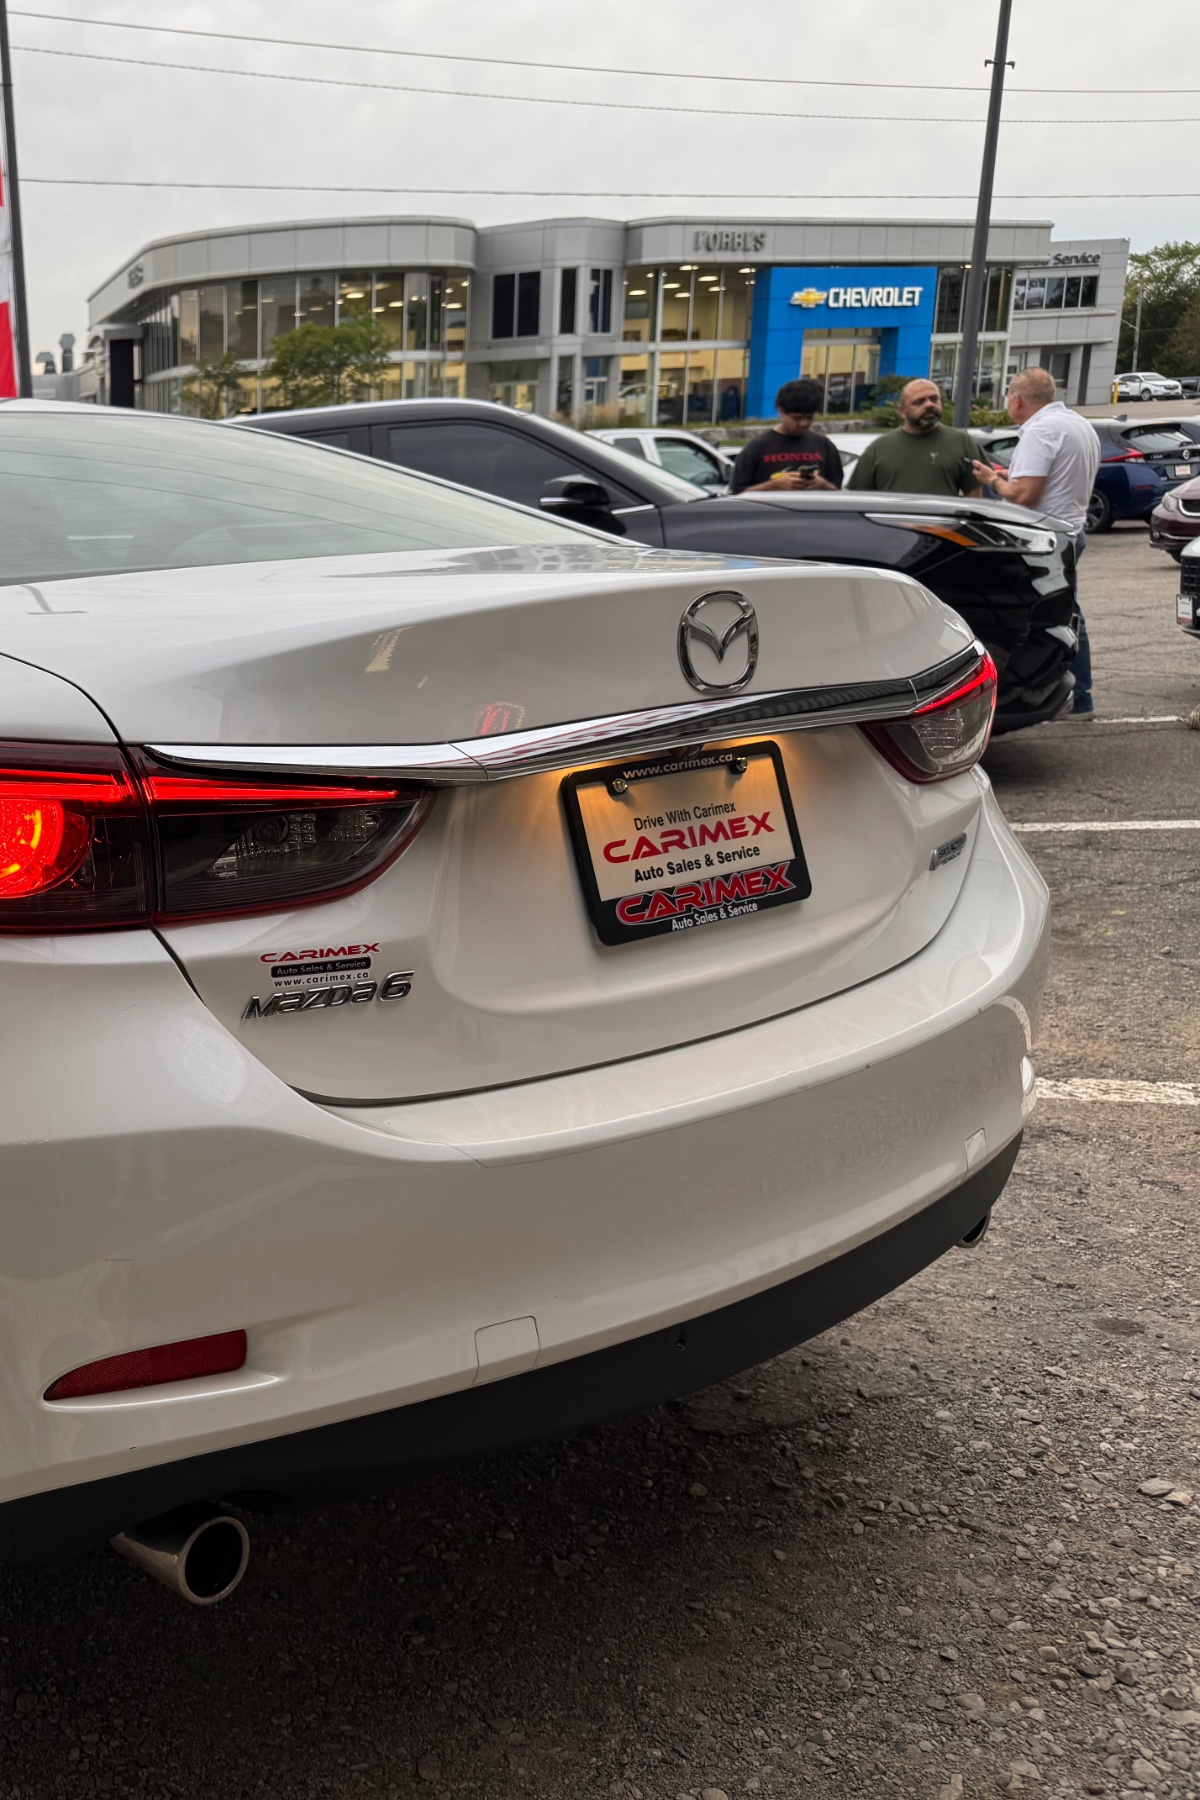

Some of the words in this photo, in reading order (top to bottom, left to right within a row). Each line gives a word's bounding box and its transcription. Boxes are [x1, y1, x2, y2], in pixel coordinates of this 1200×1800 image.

[1053, 252, 1101, 265] Service
[828, 286, 923, 308] CHEVROLET
[764, 452, 823, 463] HONDA
[623, 752, 734, 779] www.carimex.ca
[633, 815, 664, 831] Drive
[665, 808, 691, 827] With
[693, 800, 736, 819] Carimex
[603, 811, 775, 863] CARIMEX
[634, 866, 664, 883] Auto
[667, 859, 702, 875] Sales
[704, 853, 714, 866] &
[716, 844, 760, 864] Service
[616, 861, 795, 924] CARIMEX
[671, 917, 693, 931] Auto
[695, 910, 718, 925] Sales
[719, 907, 727, 919] &
[728, 901, 758, 917] Service
[260, 942, 380, 963] CARIMEX
[274, 971, 369, 987] www.carimex.ca
[276, 966, 298, 976] Auto
[300, 964, 325, 974] Sales
[326, 962, 333, 970] &
[335, 960, 367, 970] Service
